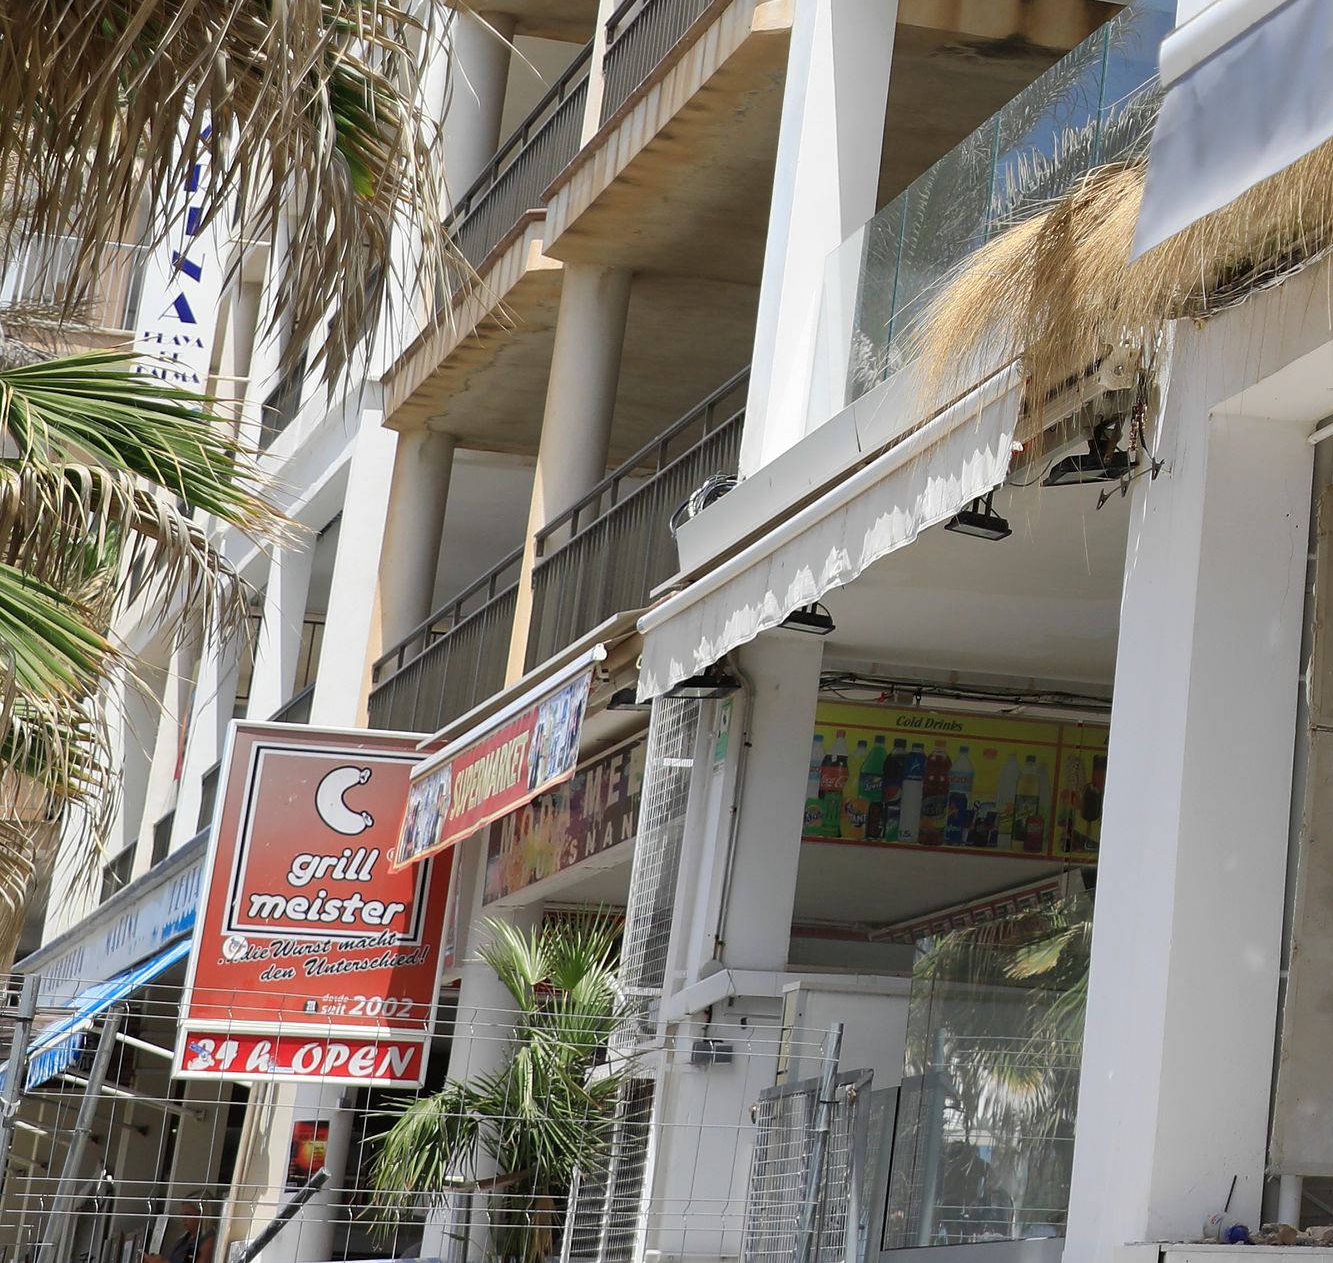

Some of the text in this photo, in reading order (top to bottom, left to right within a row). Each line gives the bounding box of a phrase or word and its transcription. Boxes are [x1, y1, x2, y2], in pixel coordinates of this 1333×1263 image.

[144, 331, 204, 349] PLAYA
[896, 716, 963, 732] Cold Drinks
[449, 730, 529, 821] SUPERMARKET
[287, 846, 380, 887] grill
[247, 889, 405, 926] meister
[269, 938, 331, 958] Wurst
[338, 928, 401, 951] macht
[259, 945, 430, 982] den Unterschied!
[321, 994, 414, 1018] seit 2002
[245, 1040, 273, 1073] h
[292, 1041, 416, 1078] OPEN
